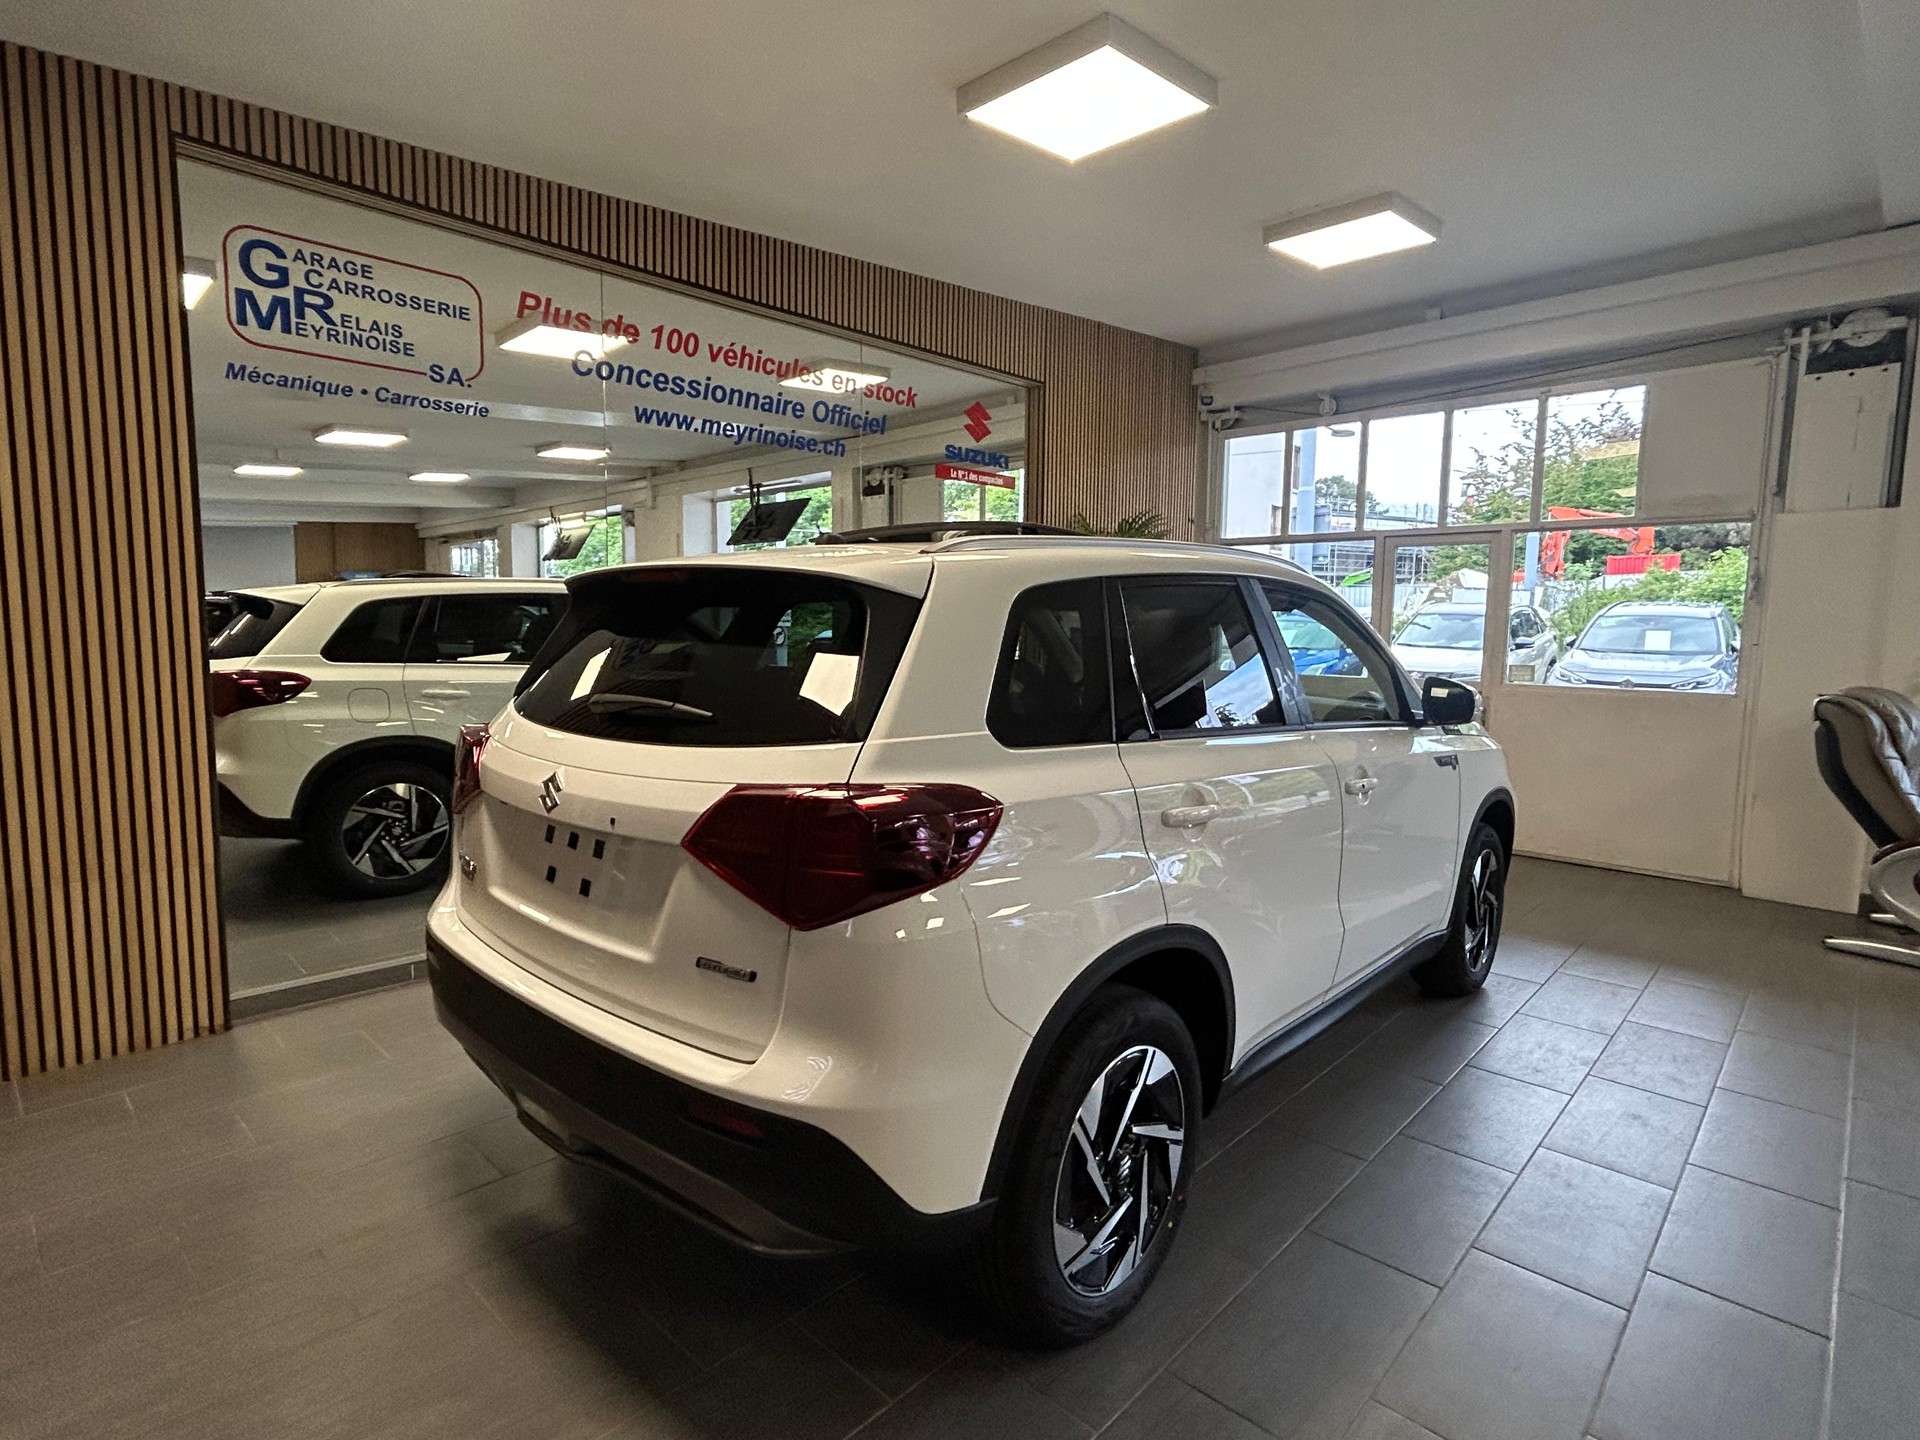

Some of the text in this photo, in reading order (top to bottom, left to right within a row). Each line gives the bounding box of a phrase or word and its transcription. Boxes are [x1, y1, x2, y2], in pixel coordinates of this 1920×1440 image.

[238, 239, 373, 290] GARAGE
[293, 286, 403, 338] RELAIS
[304, 269, 471, 321] CARROSSERIE
[234, 287, 415, 358] MEYRINOISE
[516, 291, 919, 408] Plus de 100 véhicules en stock
[225, 362, 490, 418] Mécanique Carrosserie
[571, 350, 887, 435] Concessionnaire Officiel
[634, 406, 846, 457] www.meyrinoise.ch
[944, 444, 1009, 469] SUZUKI
